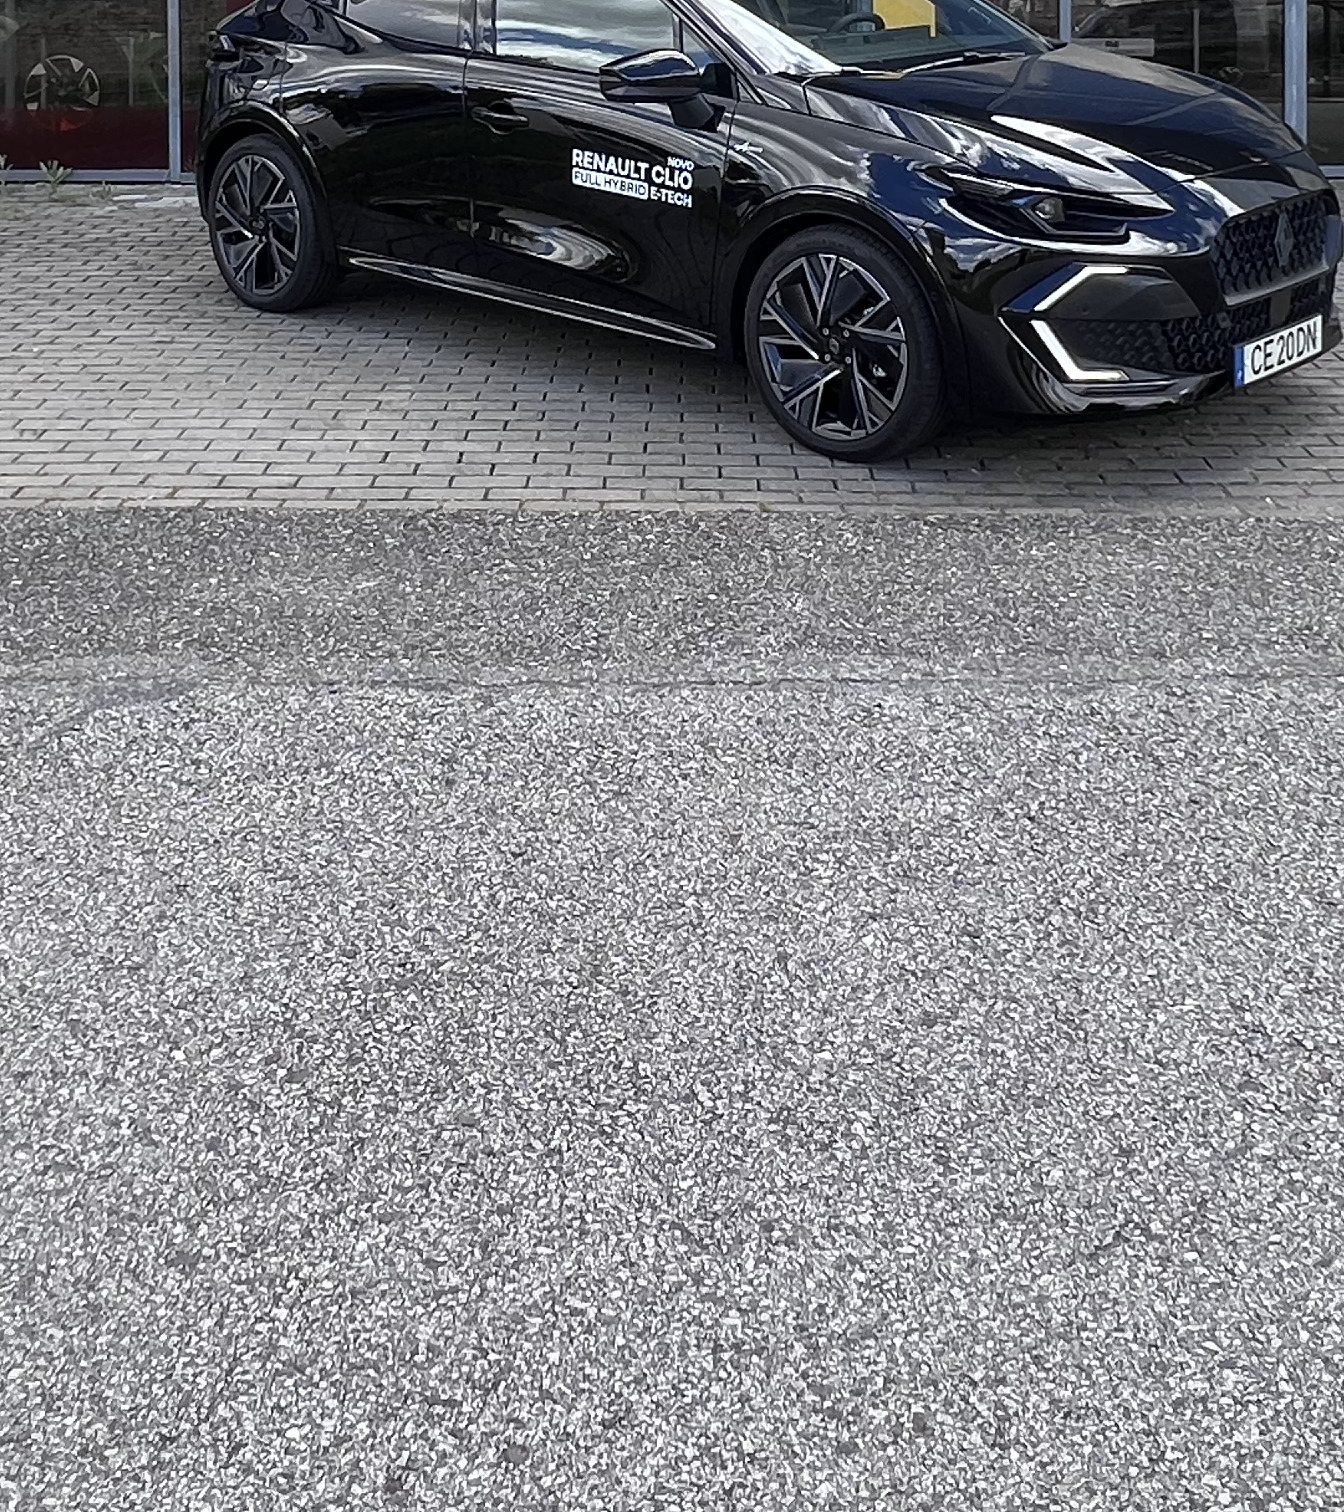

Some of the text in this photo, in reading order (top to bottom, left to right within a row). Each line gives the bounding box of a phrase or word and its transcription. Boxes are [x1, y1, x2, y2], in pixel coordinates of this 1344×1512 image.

[572, 148, 693, 190] RENAULT CLIO
[667, 156, 694, 171] NOVO
[574, 170, 692, 207] FULL HYBRID E-TECH
